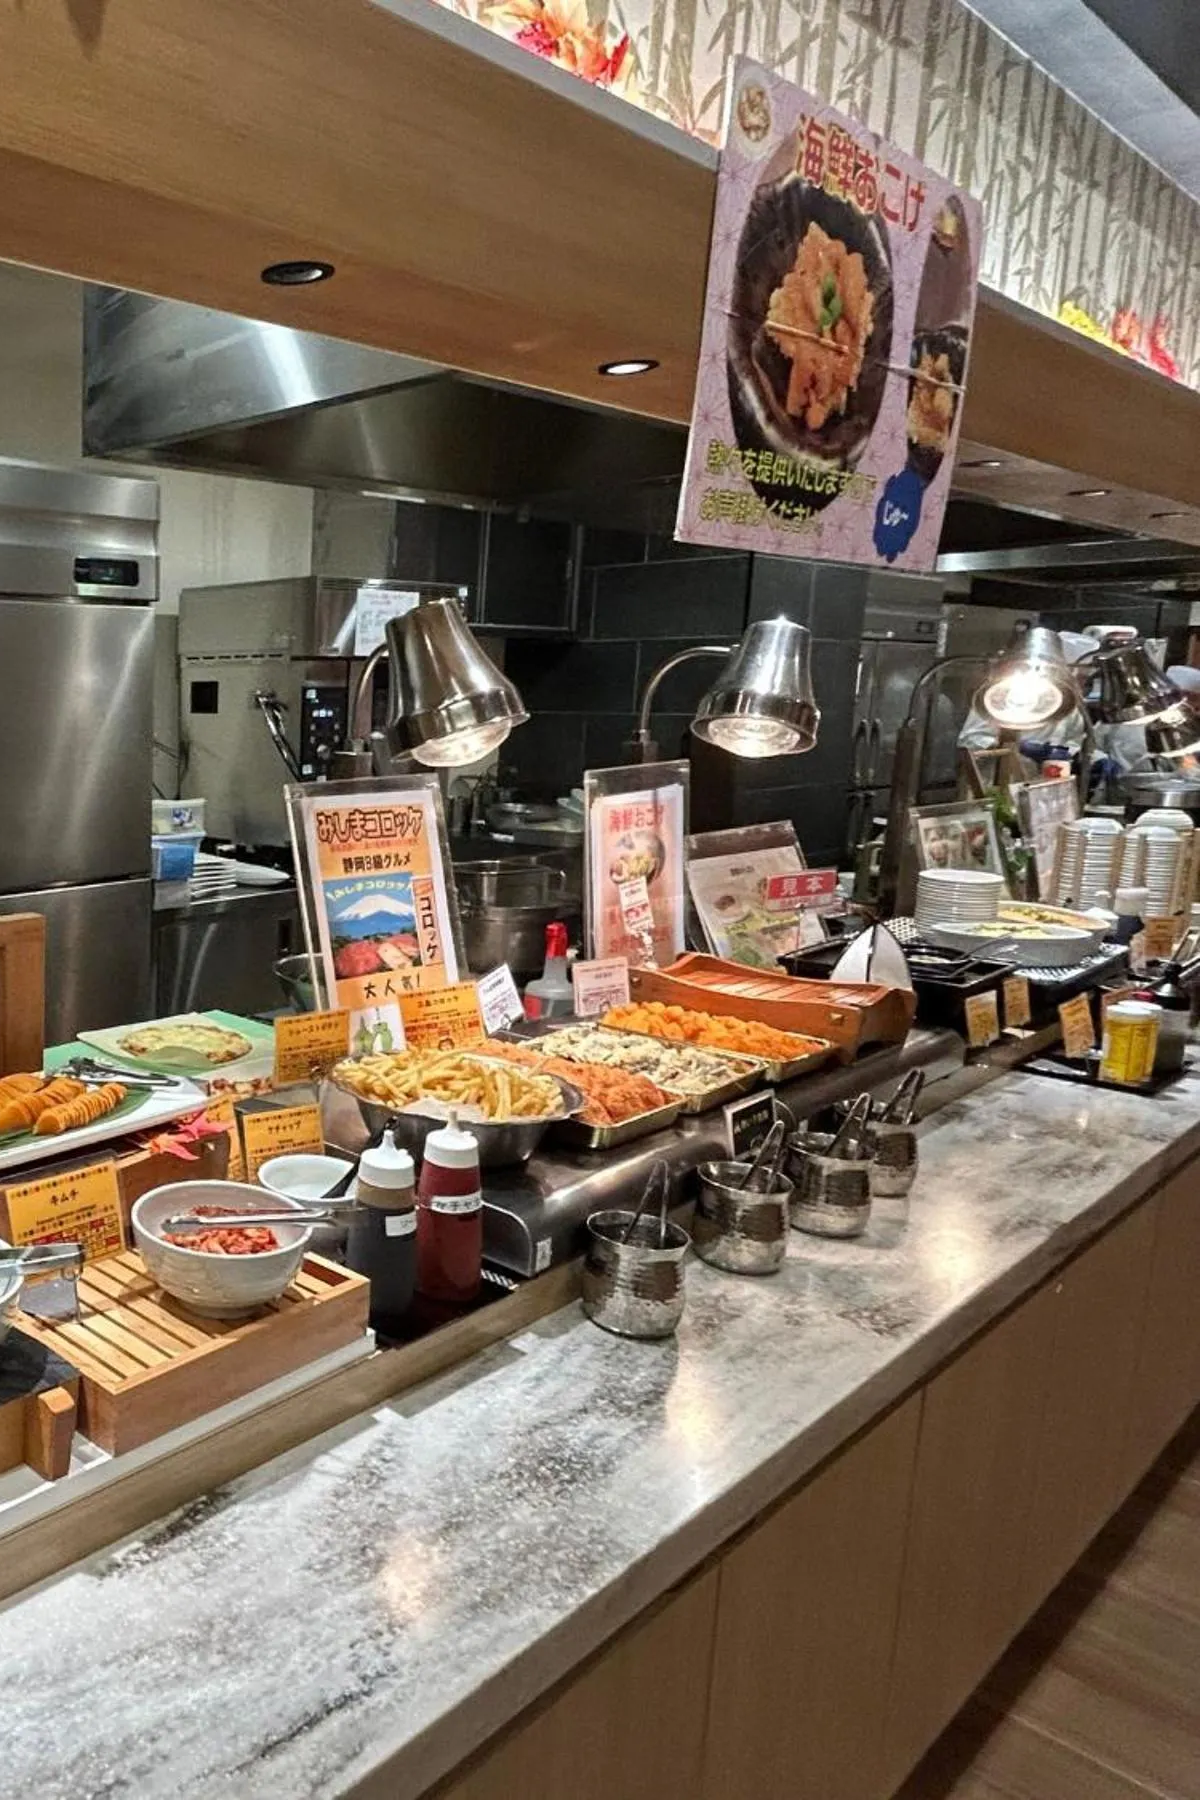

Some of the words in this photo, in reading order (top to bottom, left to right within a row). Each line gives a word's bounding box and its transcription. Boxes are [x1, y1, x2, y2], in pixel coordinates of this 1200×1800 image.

[315, 806, 423, 845] みしまコロッケ
[780, 876, 824, 897] 見本
[419, 896, 438, 960] コロッケ
[50, 1188, 79, 1207] キムチ
